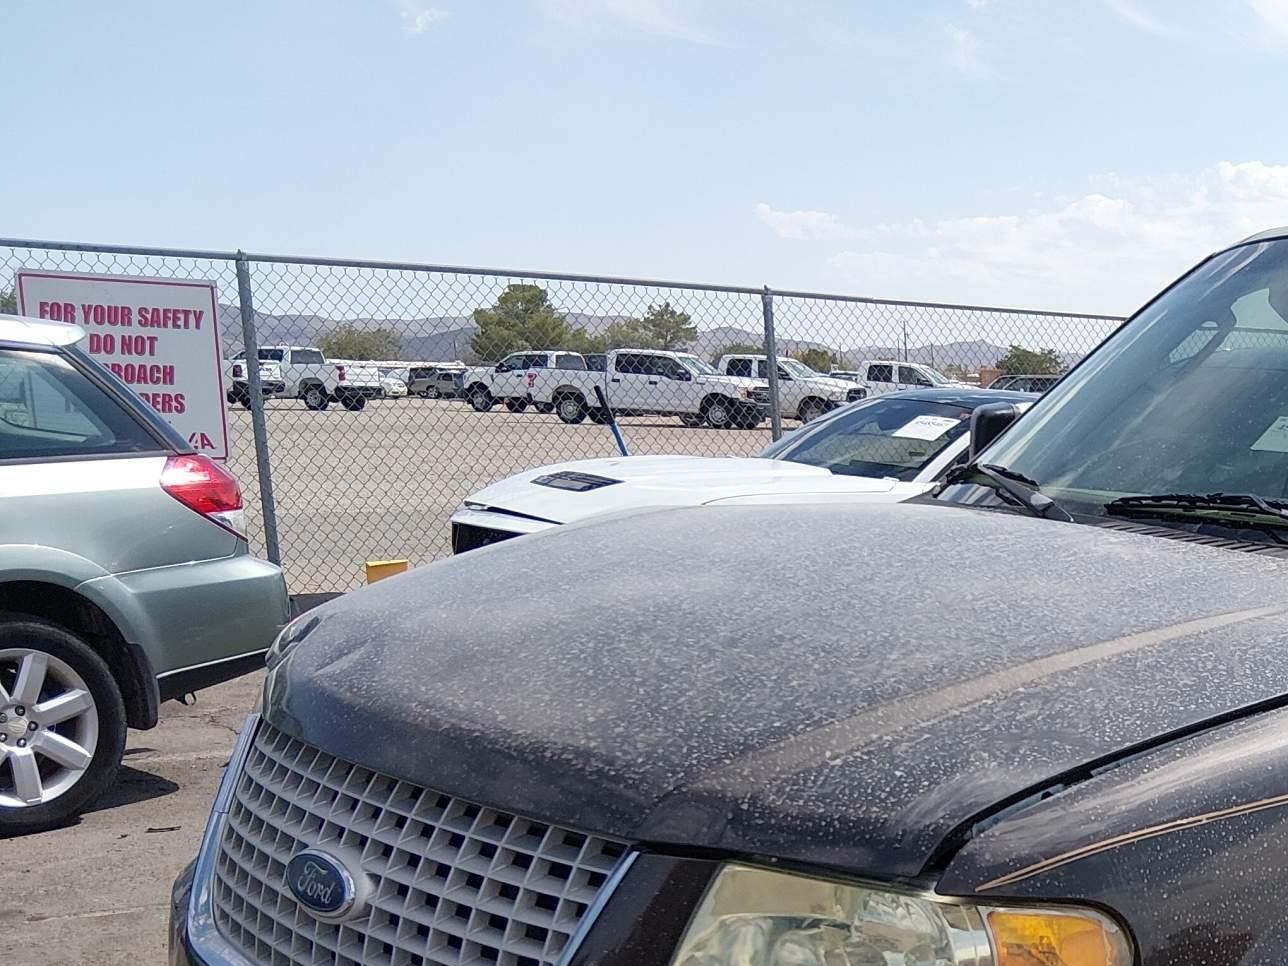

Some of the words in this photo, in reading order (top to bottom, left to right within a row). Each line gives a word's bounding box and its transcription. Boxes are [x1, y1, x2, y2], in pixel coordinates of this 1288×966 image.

[39, 301, 76, 324] FOR
[81, 303, 133, 327] YOUR
[137, 306, 204, 330] SAFETY
[89, 333, 115, 355] DO
[120, 335, 158, 356] NOT
[297, 861, 336, 904] Ford
